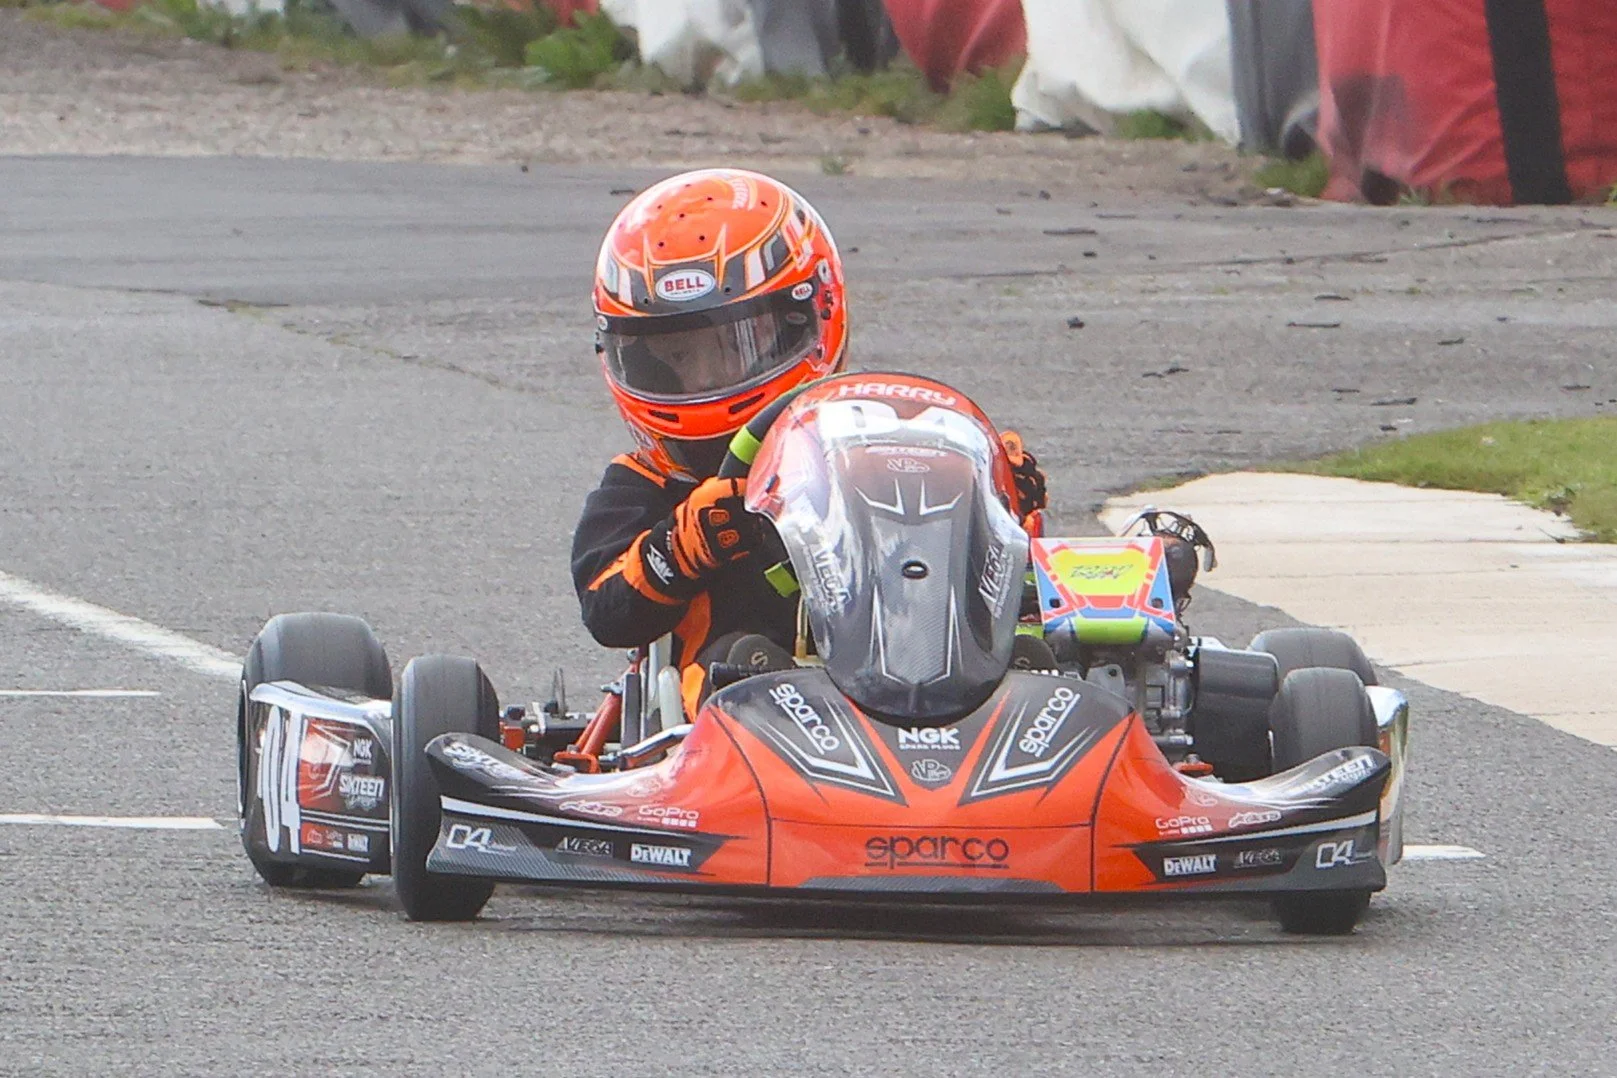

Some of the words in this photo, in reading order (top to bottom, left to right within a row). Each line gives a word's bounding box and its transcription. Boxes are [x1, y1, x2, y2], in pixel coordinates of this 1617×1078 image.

[664, 276, 705, 292] BELL
[838, 382, 957, 406] HARRY
[770, 683, 840, 753] sparco
[1018, 687, 1078, 755] sparco
[897, 727, 960, 744] NGK
[353, 738, 373, 759] NGK
[638, 805, 700, 820] GoPro
[1155, 815, 1210, 830] GoPro
[864, 835, 1010, 870] sparco
